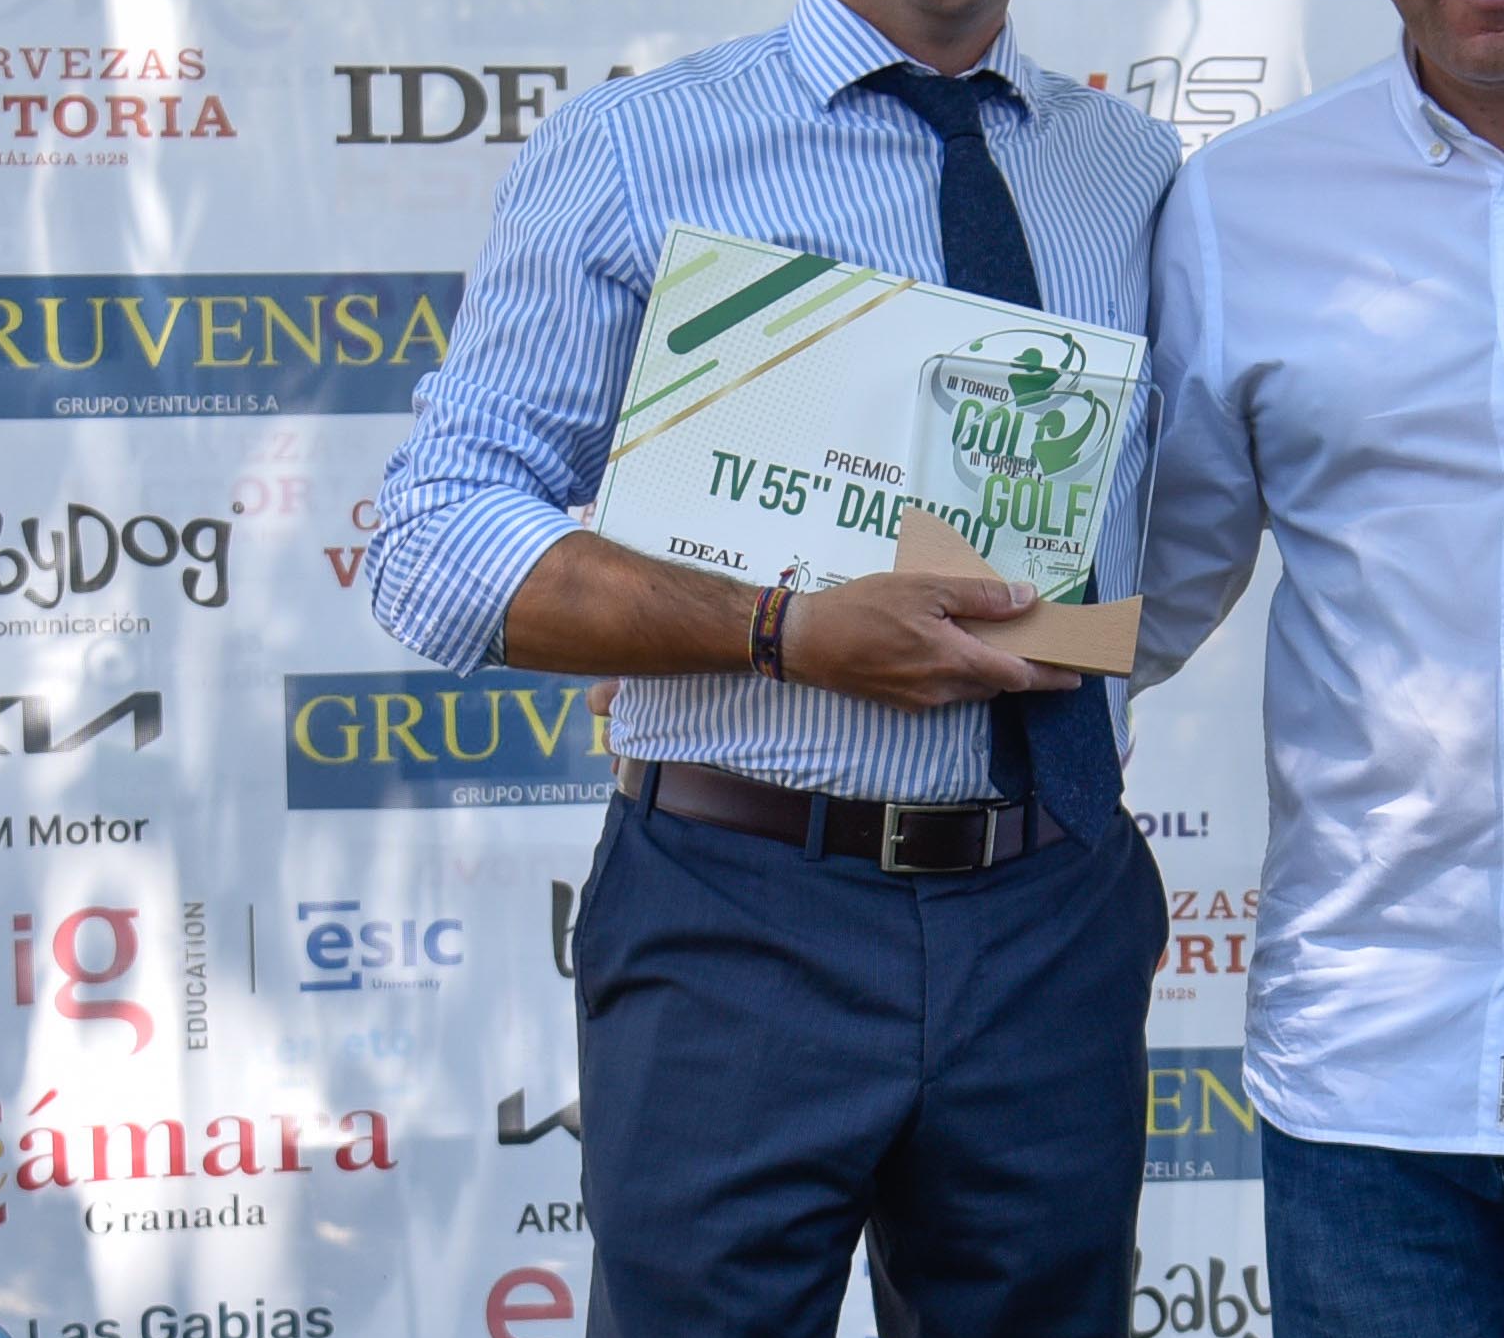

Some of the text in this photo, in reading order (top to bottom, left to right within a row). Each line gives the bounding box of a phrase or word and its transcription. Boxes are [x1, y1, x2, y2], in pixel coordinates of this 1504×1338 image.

[333, 63, 637, 146] IDE
[86, 149, 130, 167] 1928
[55, 394, 129, 417] GRUPO
[133, 393, 244, 415] VENTUCELI
[960, 377, 1010, 403] TORNEO
[709, 449, 758, 502] TV
[824, 449, 906, 487] PREMIO:
[981, 473, 1094, 538] GOLF
[666, 536, 748, 571] IDEAL
[1024, 535, 1086, 555] IDEAL
[294, 687, 612, 766] GRUV
[451, 782, 615, 805] GRUPO VENTUCE
[27, 812, 150, 850] Motor
[187, 900, 208, 1051] EDUCATION
[1157, 988, 1197, 1001] 1928
[84, 1193, 267, 1236] Granada
